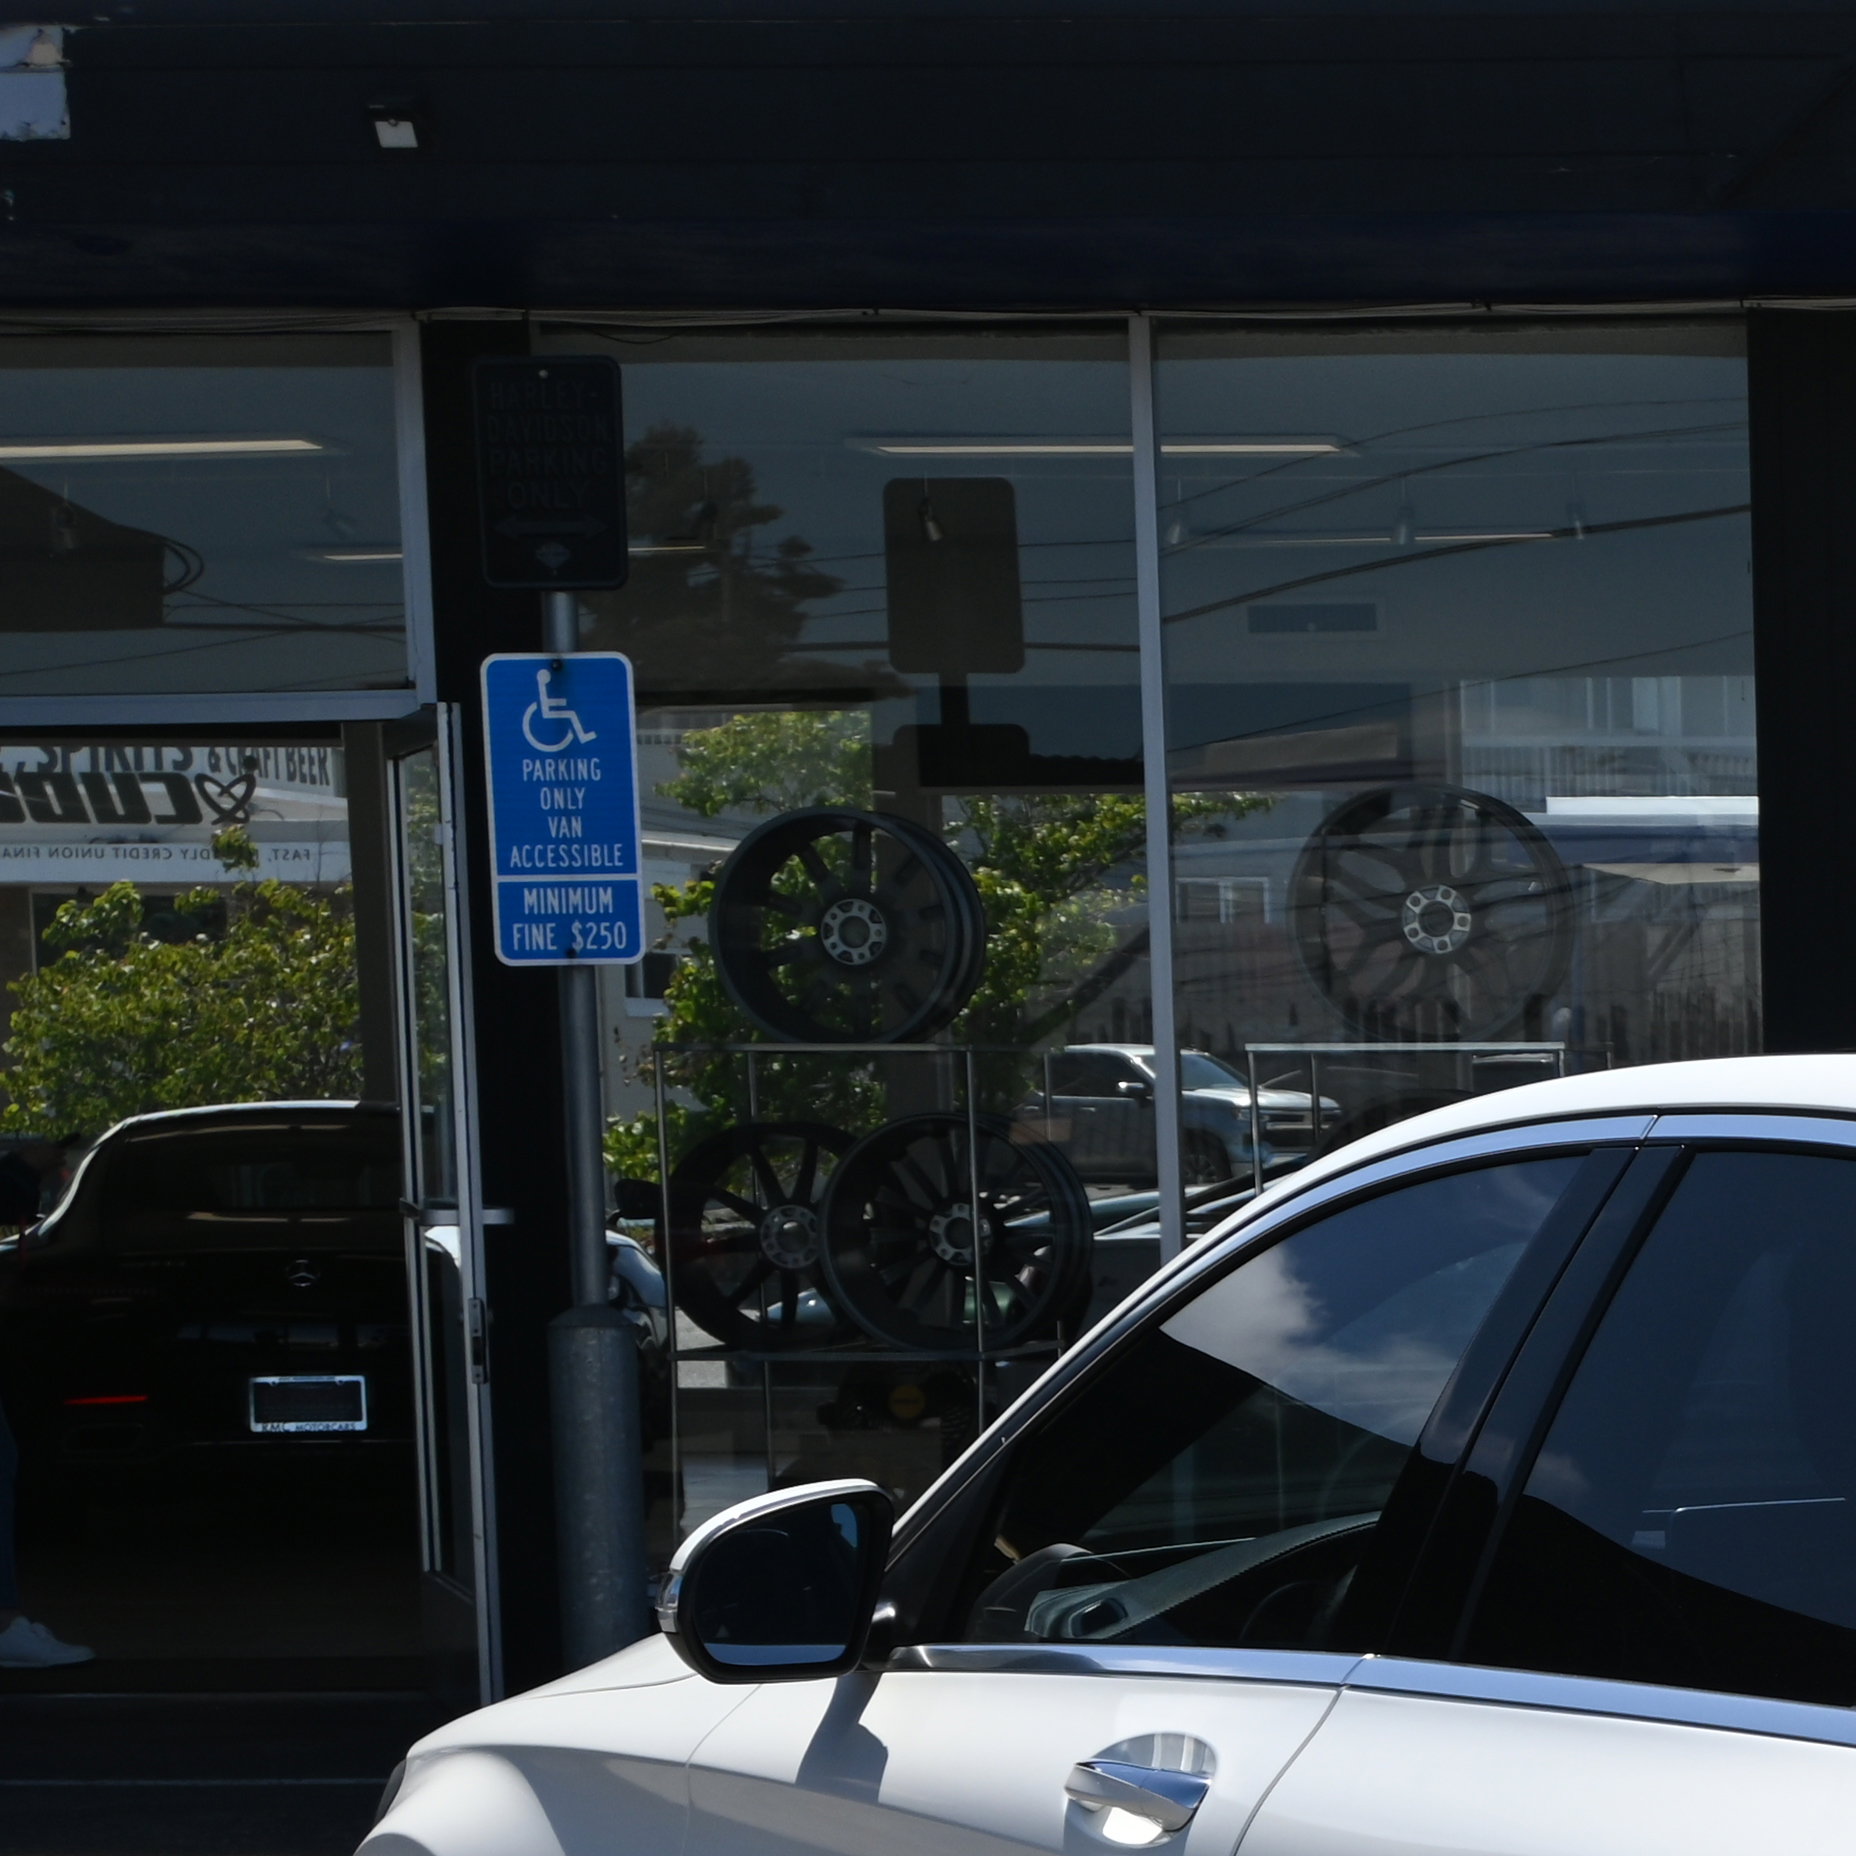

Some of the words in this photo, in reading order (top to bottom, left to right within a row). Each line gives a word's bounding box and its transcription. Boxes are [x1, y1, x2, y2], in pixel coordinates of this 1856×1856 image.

[487, 414, 613, 443] DAVIDSON
[489, 449, 607, 476] PARKING
[507, 481, 590, 510] ONLY
[522, 758, 602, 782] PARKING
[540, 786, 586, 811] ONLY
[548, 815, 583, 839] VAN
[510, 843, 624, 868] ACCESSIBLE
[523, 886, 614, 916] MINIMUM
[512, 922, 558, 951] FINE
[571, 919, 628, 950] $250
